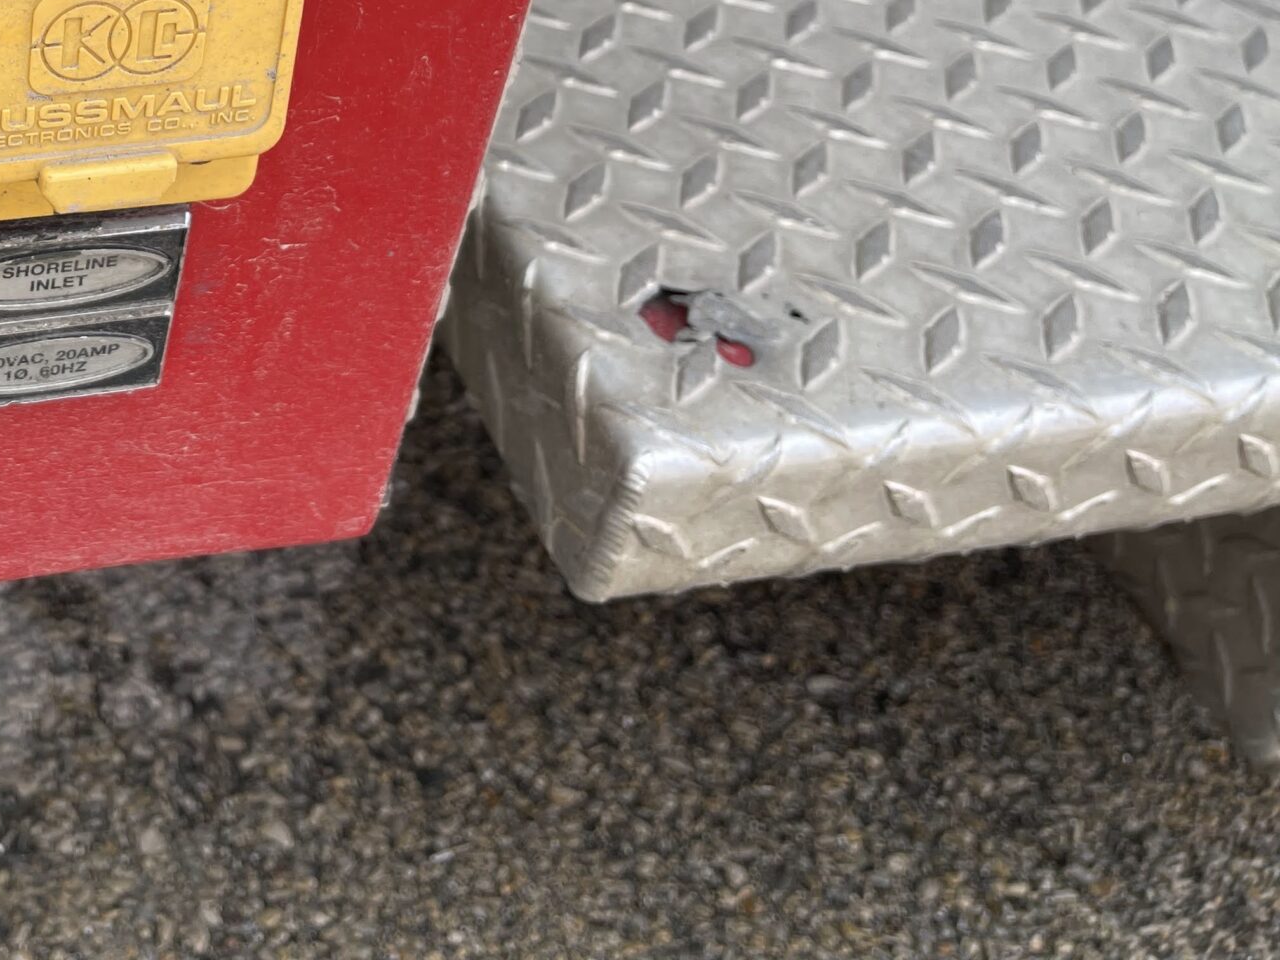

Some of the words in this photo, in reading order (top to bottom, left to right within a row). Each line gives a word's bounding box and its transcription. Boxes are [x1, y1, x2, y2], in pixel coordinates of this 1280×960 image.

[210, 109, 256, 125] INC.
[2, 255, 119, 280] SHORELINE
[30, 275, 88, 292] INLET
[56, 343, 120, 361] 20AMP
[40, 356, 87, 378] 60HZ
